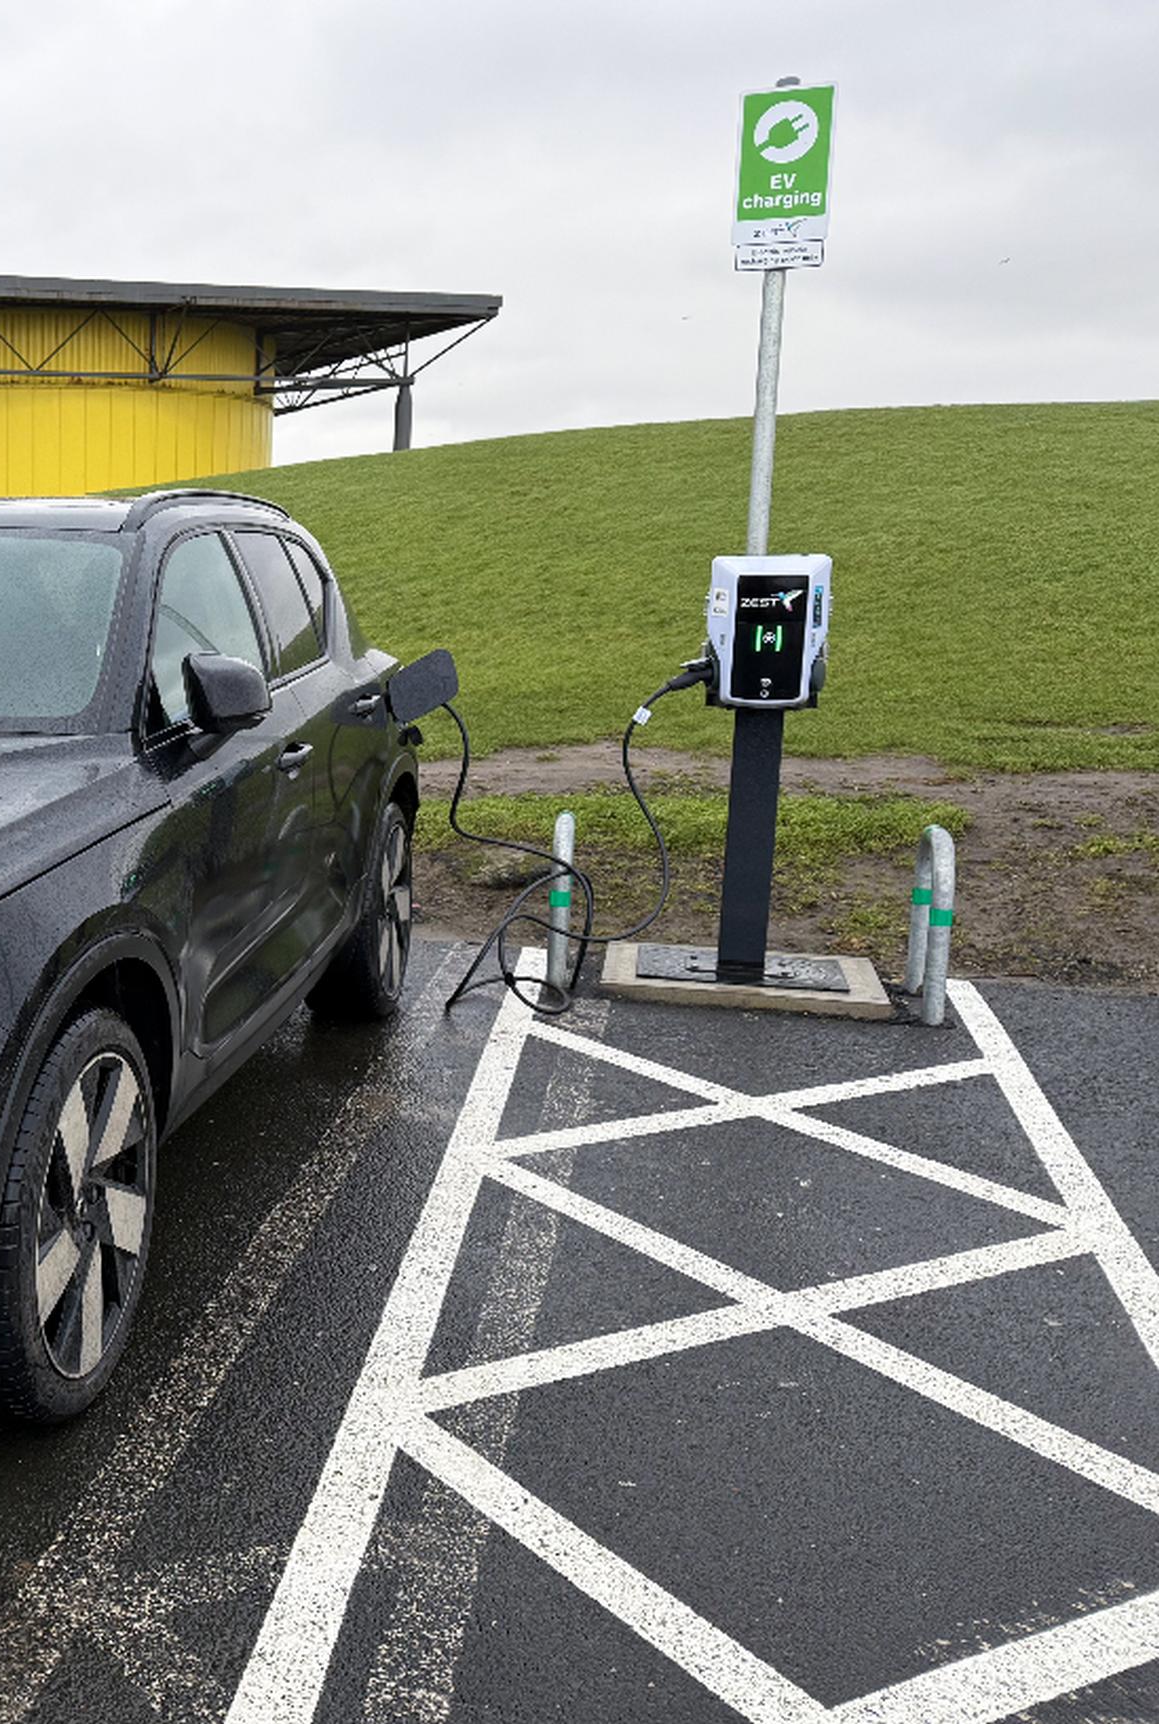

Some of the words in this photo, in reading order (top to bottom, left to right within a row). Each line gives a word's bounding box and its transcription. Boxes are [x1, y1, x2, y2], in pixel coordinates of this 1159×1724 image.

[770, 173, 797, 190] EV
[742, 191, 822, 209] charging
[740, 597, 780, 608] ZEST
